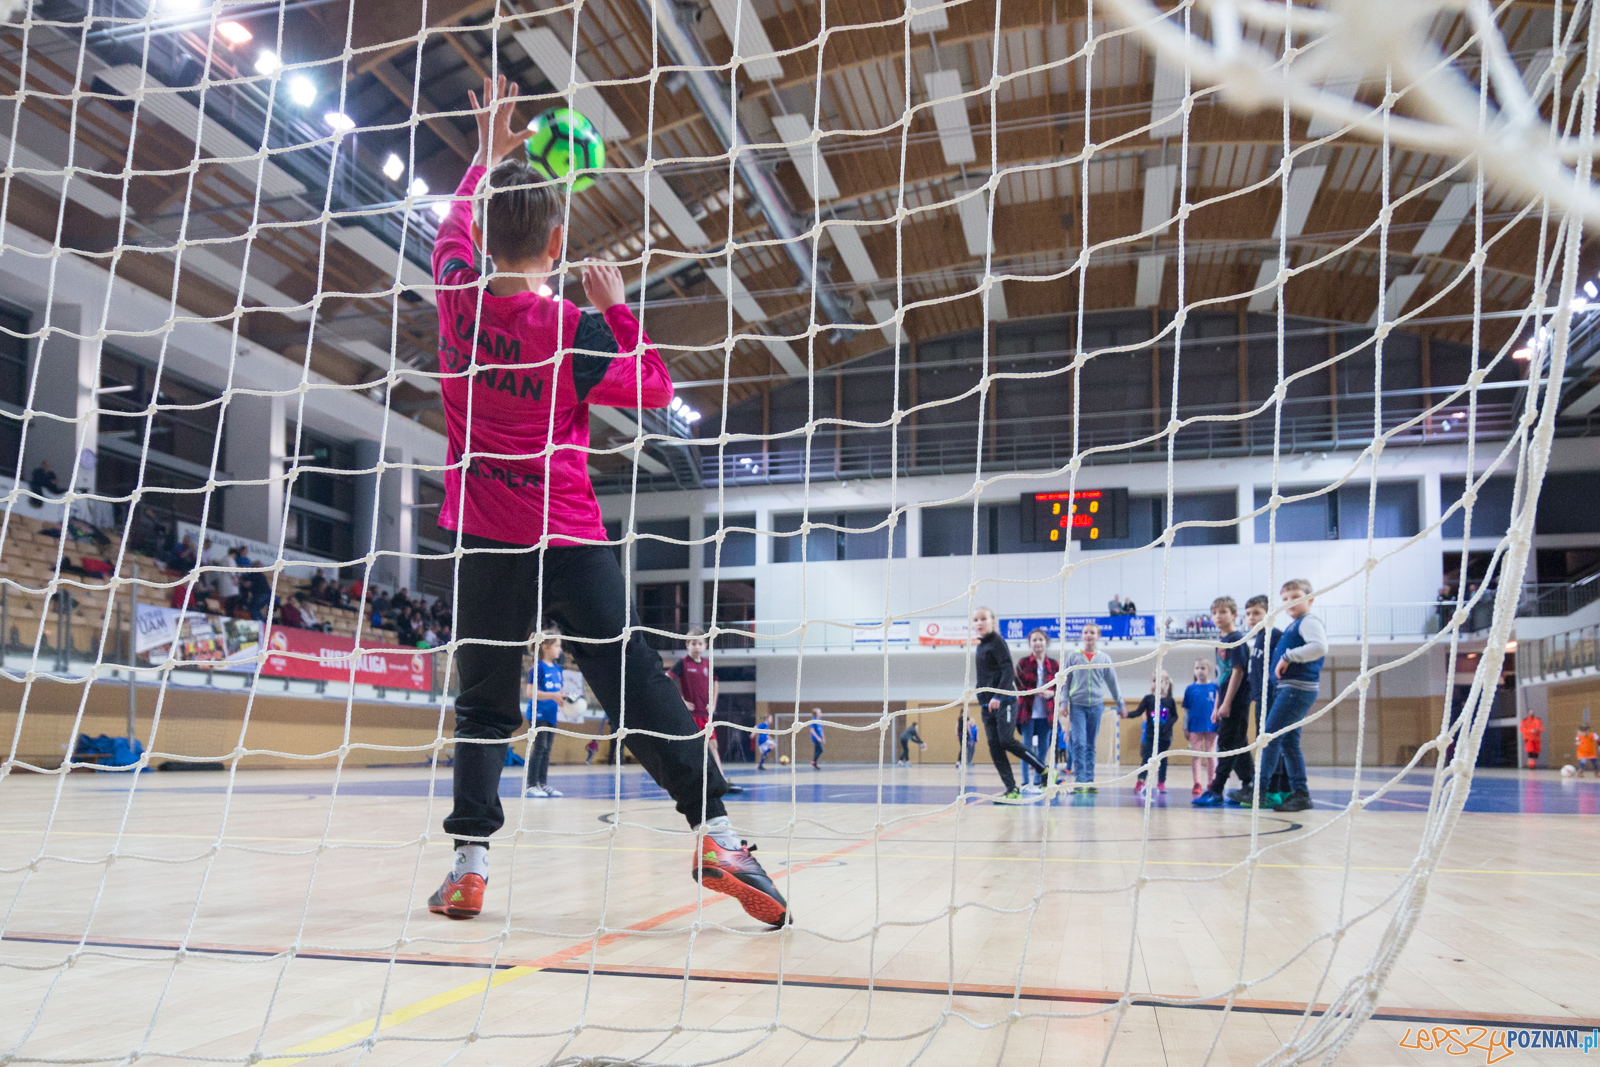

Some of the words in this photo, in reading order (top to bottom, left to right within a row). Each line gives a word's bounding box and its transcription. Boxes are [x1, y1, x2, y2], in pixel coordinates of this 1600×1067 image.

[455, 313, 521, 362] UAM
[1089, 500, 1099, 513] 0
[1049, 529, 1059, 541] 0
[1090, 527, 1100, 540] 0
